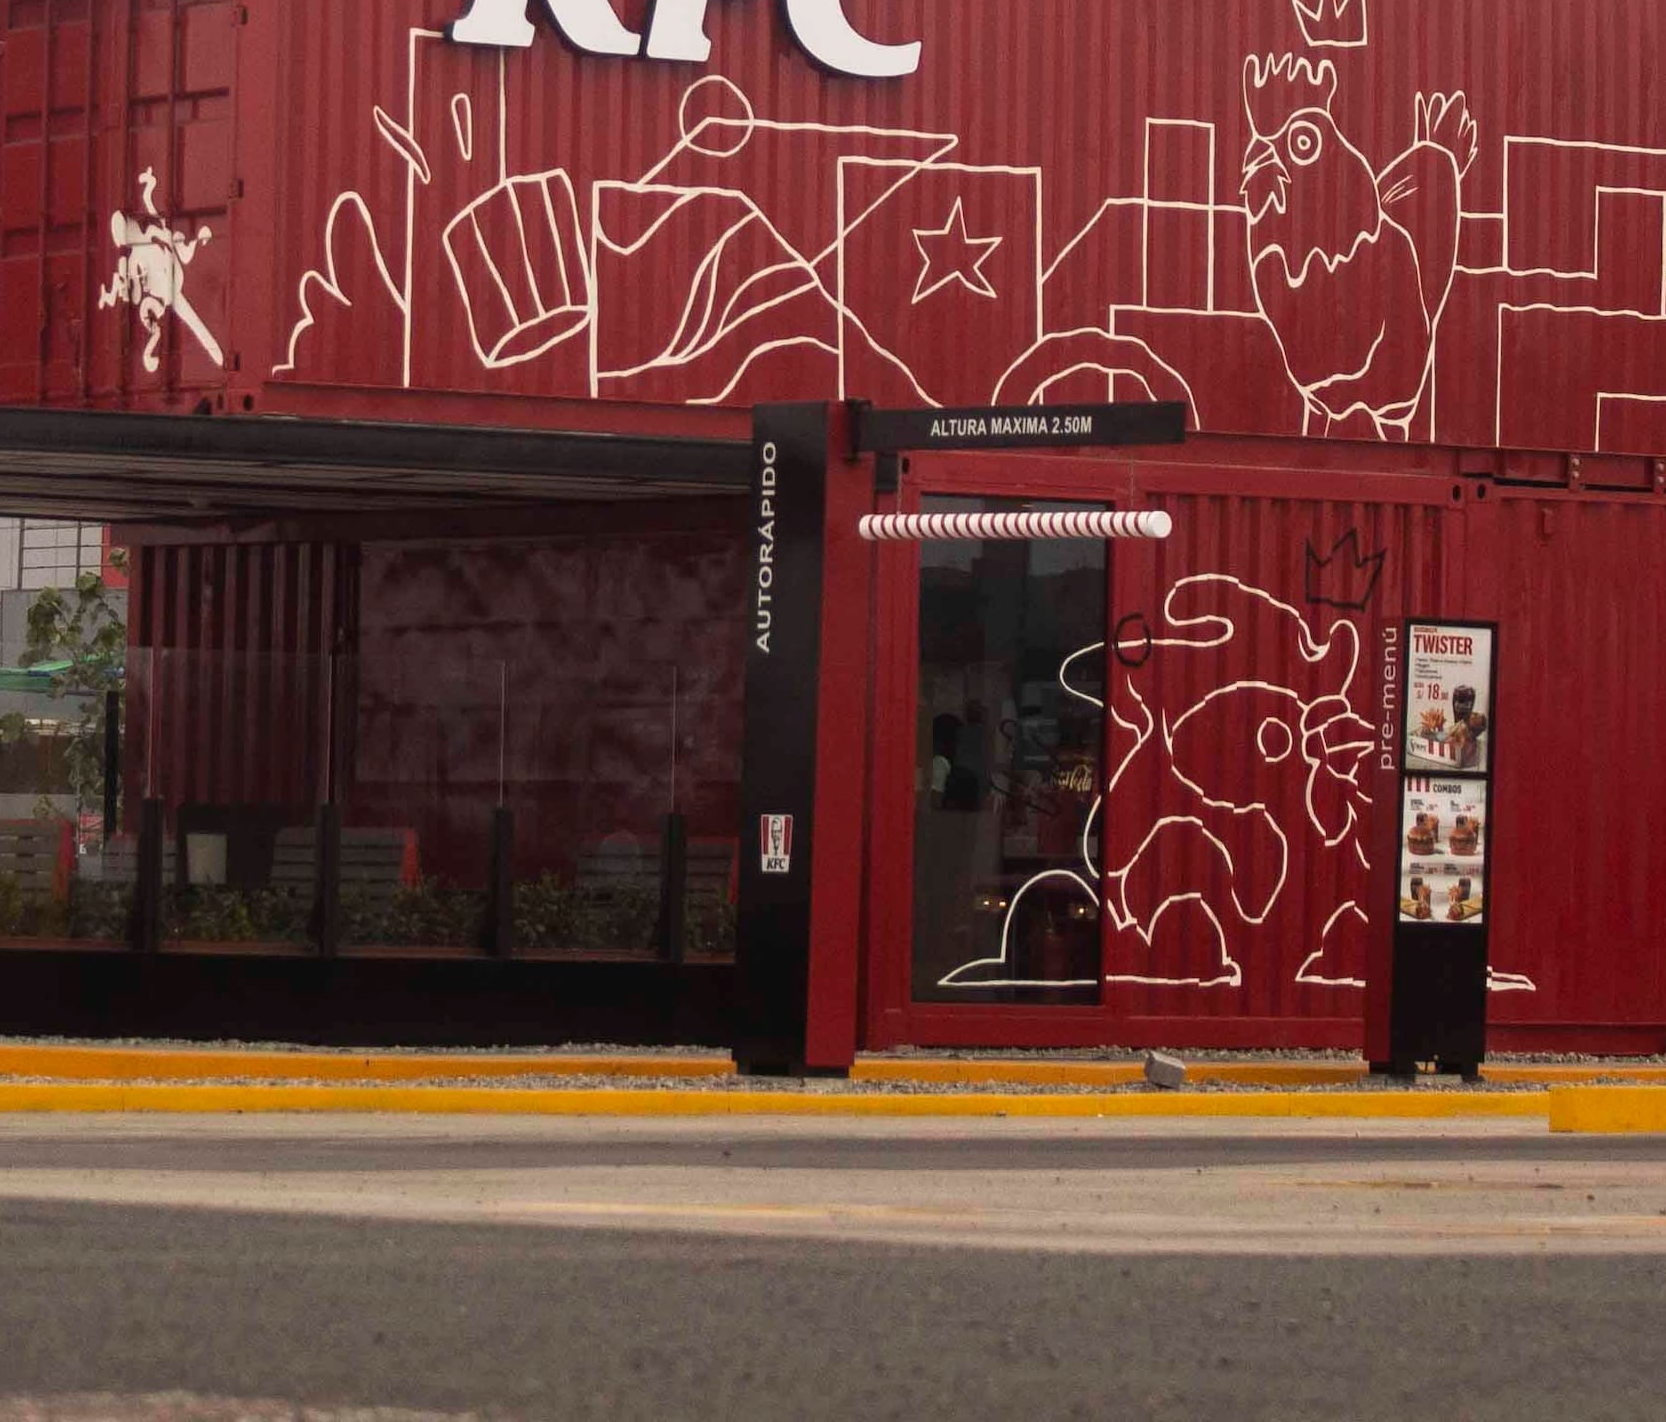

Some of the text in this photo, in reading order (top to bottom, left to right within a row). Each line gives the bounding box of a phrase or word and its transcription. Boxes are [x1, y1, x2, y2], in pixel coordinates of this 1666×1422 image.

[930, 416, 1092, 437] ALTURA MAXIMA 2.50M
[755, 441, 776, 653] AUTORÁPIDO
[1413, 634, 1473, 655] TWISTER
[1380, 627, 1398, 769] pre-menú
[1433, 783, 1462, 794] COMBOS
[766, 858, 786, 870] KFC
